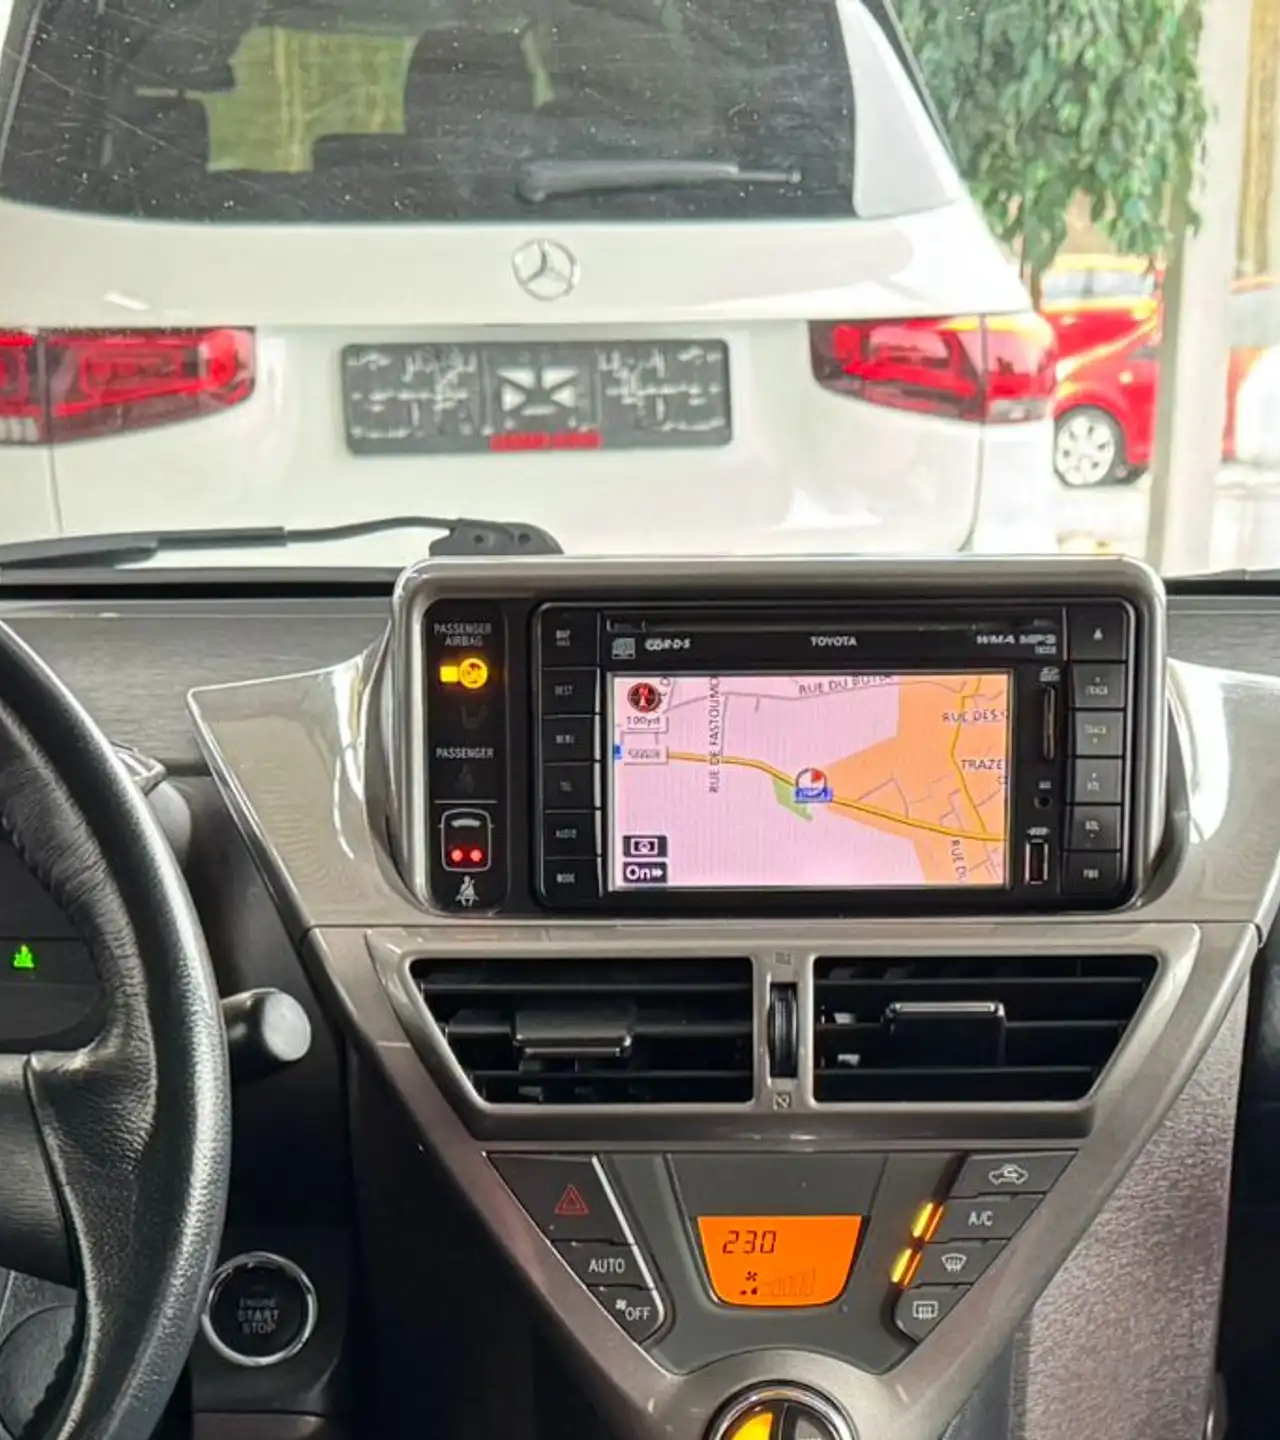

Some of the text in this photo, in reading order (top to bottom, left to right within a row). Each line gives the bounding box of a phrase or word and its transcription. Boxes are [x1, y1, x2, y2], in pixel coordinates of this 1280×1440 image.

[433, 623, 491, 635] PASSENGER
[444, 635, 483, 647] AIRBAG
[810, 635, 857, 647] TOYOTA
[798, 681, 824, 696] RUE
[828, 677, 848, 692] DU
[626, 715, 661, 728] 100yd
[941, 711, 968, 723] RUE
[973, 708, 997, 722] DES
[435, 748, 494, 760] PASSENGER
[708, 751, 720, 765] DE
[960, 759, 1004, 770] TRAZE
[708, 768, 720, 794] RUE
[626, 865, 651, 881] On
[968, 1210, 993, 1227] A/C
[588, 1258, 625, 1274] AUTO
[237, 1309, 279, 1322] START
[625, 1306, 651, 1321] OFF
[242, 1322, 276, 1334] STOP
